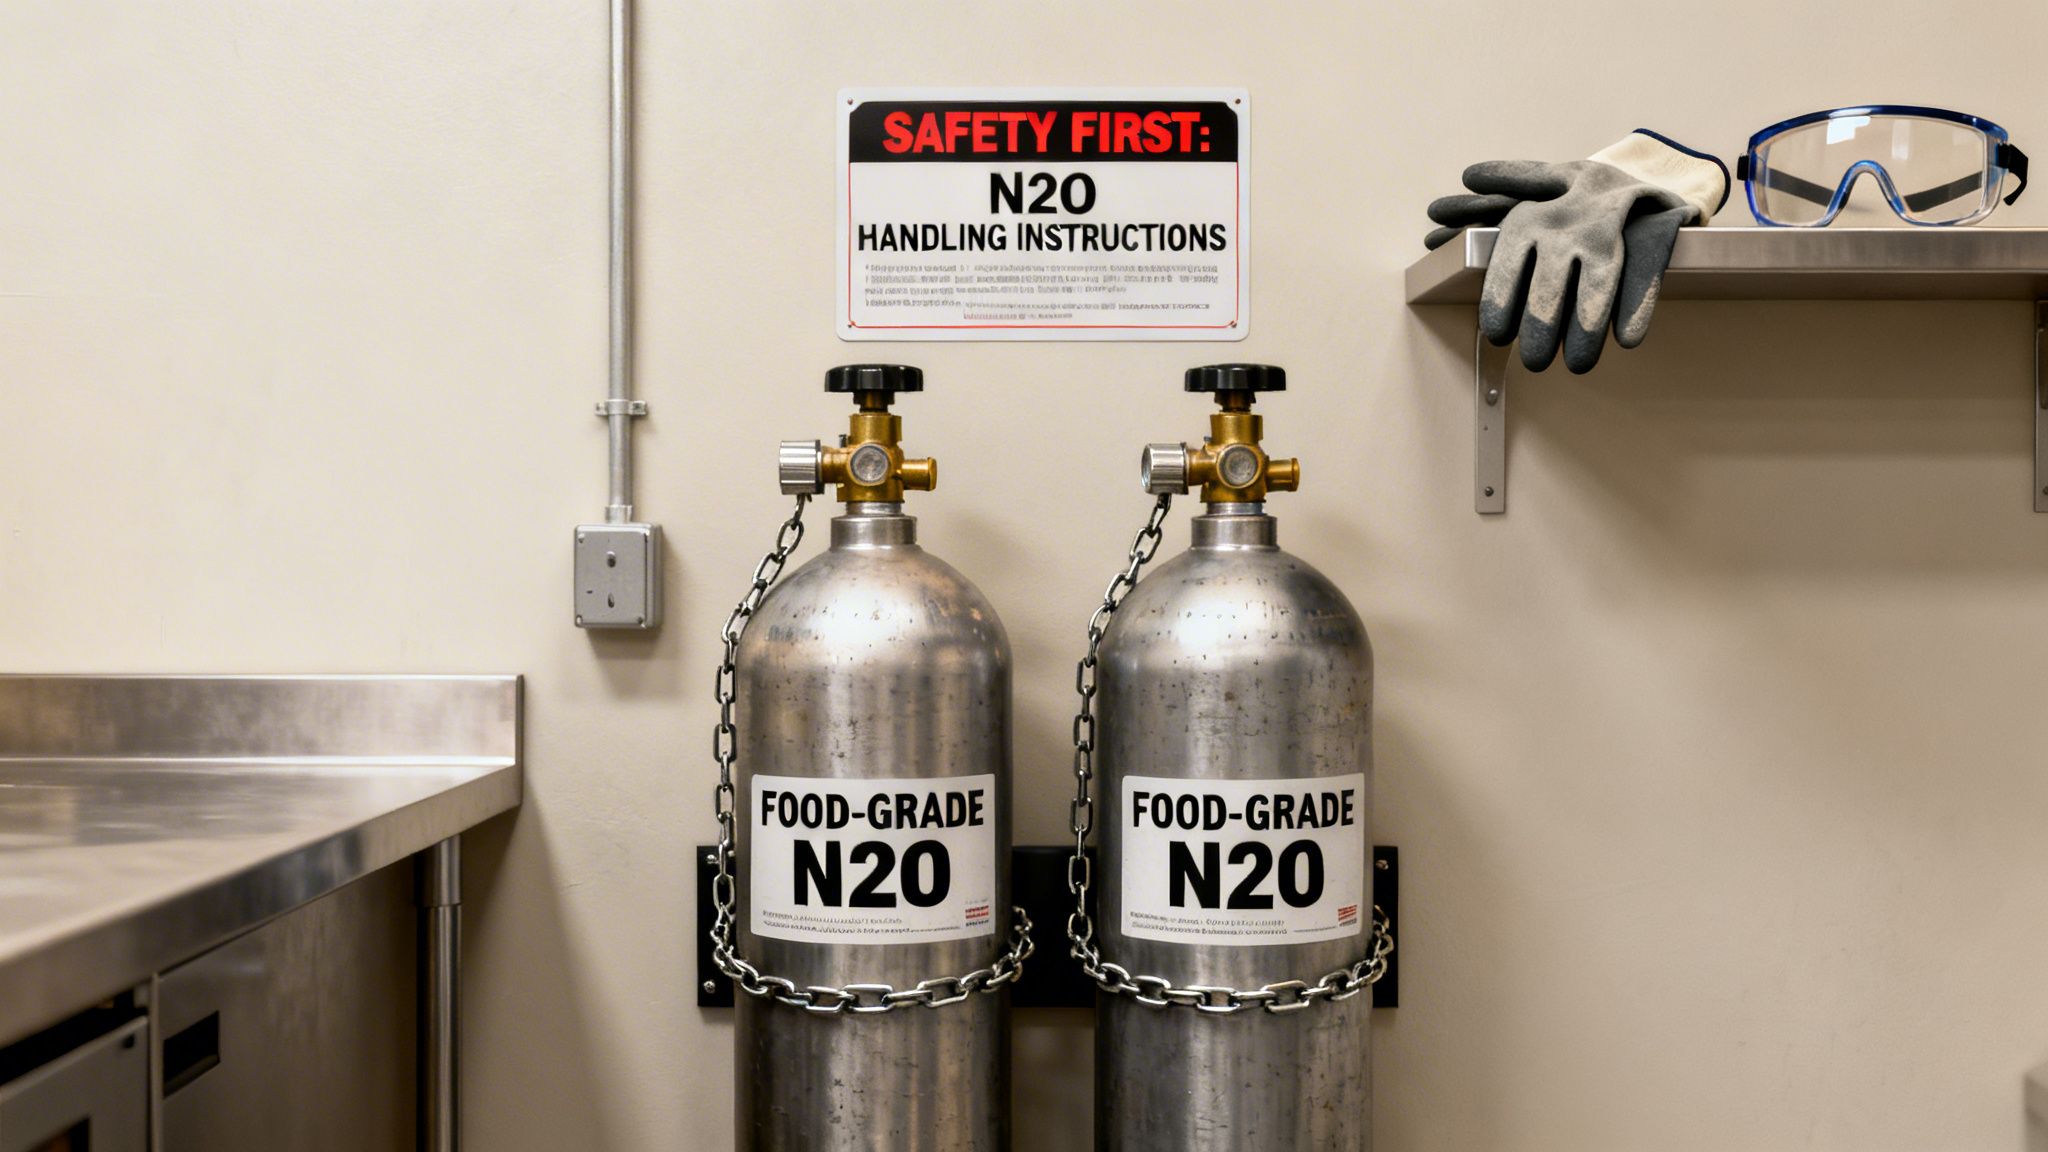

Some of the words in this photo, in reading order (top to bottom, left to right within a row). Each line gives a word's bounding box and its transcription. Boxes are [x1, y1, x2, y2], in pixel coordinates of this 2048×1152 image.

[883, 111, 1057, 153] SAFETY
[1071, 111, 1210, 153] FIRST:
[858, 223, 1007, 252] HANDLING
[1017, 223, 1227, 252] INSTRUCTIONS
[762, 789, 984, 829] FOOD-GRADE
[1133, 789, 1355, 830] FOOD-GRADE
